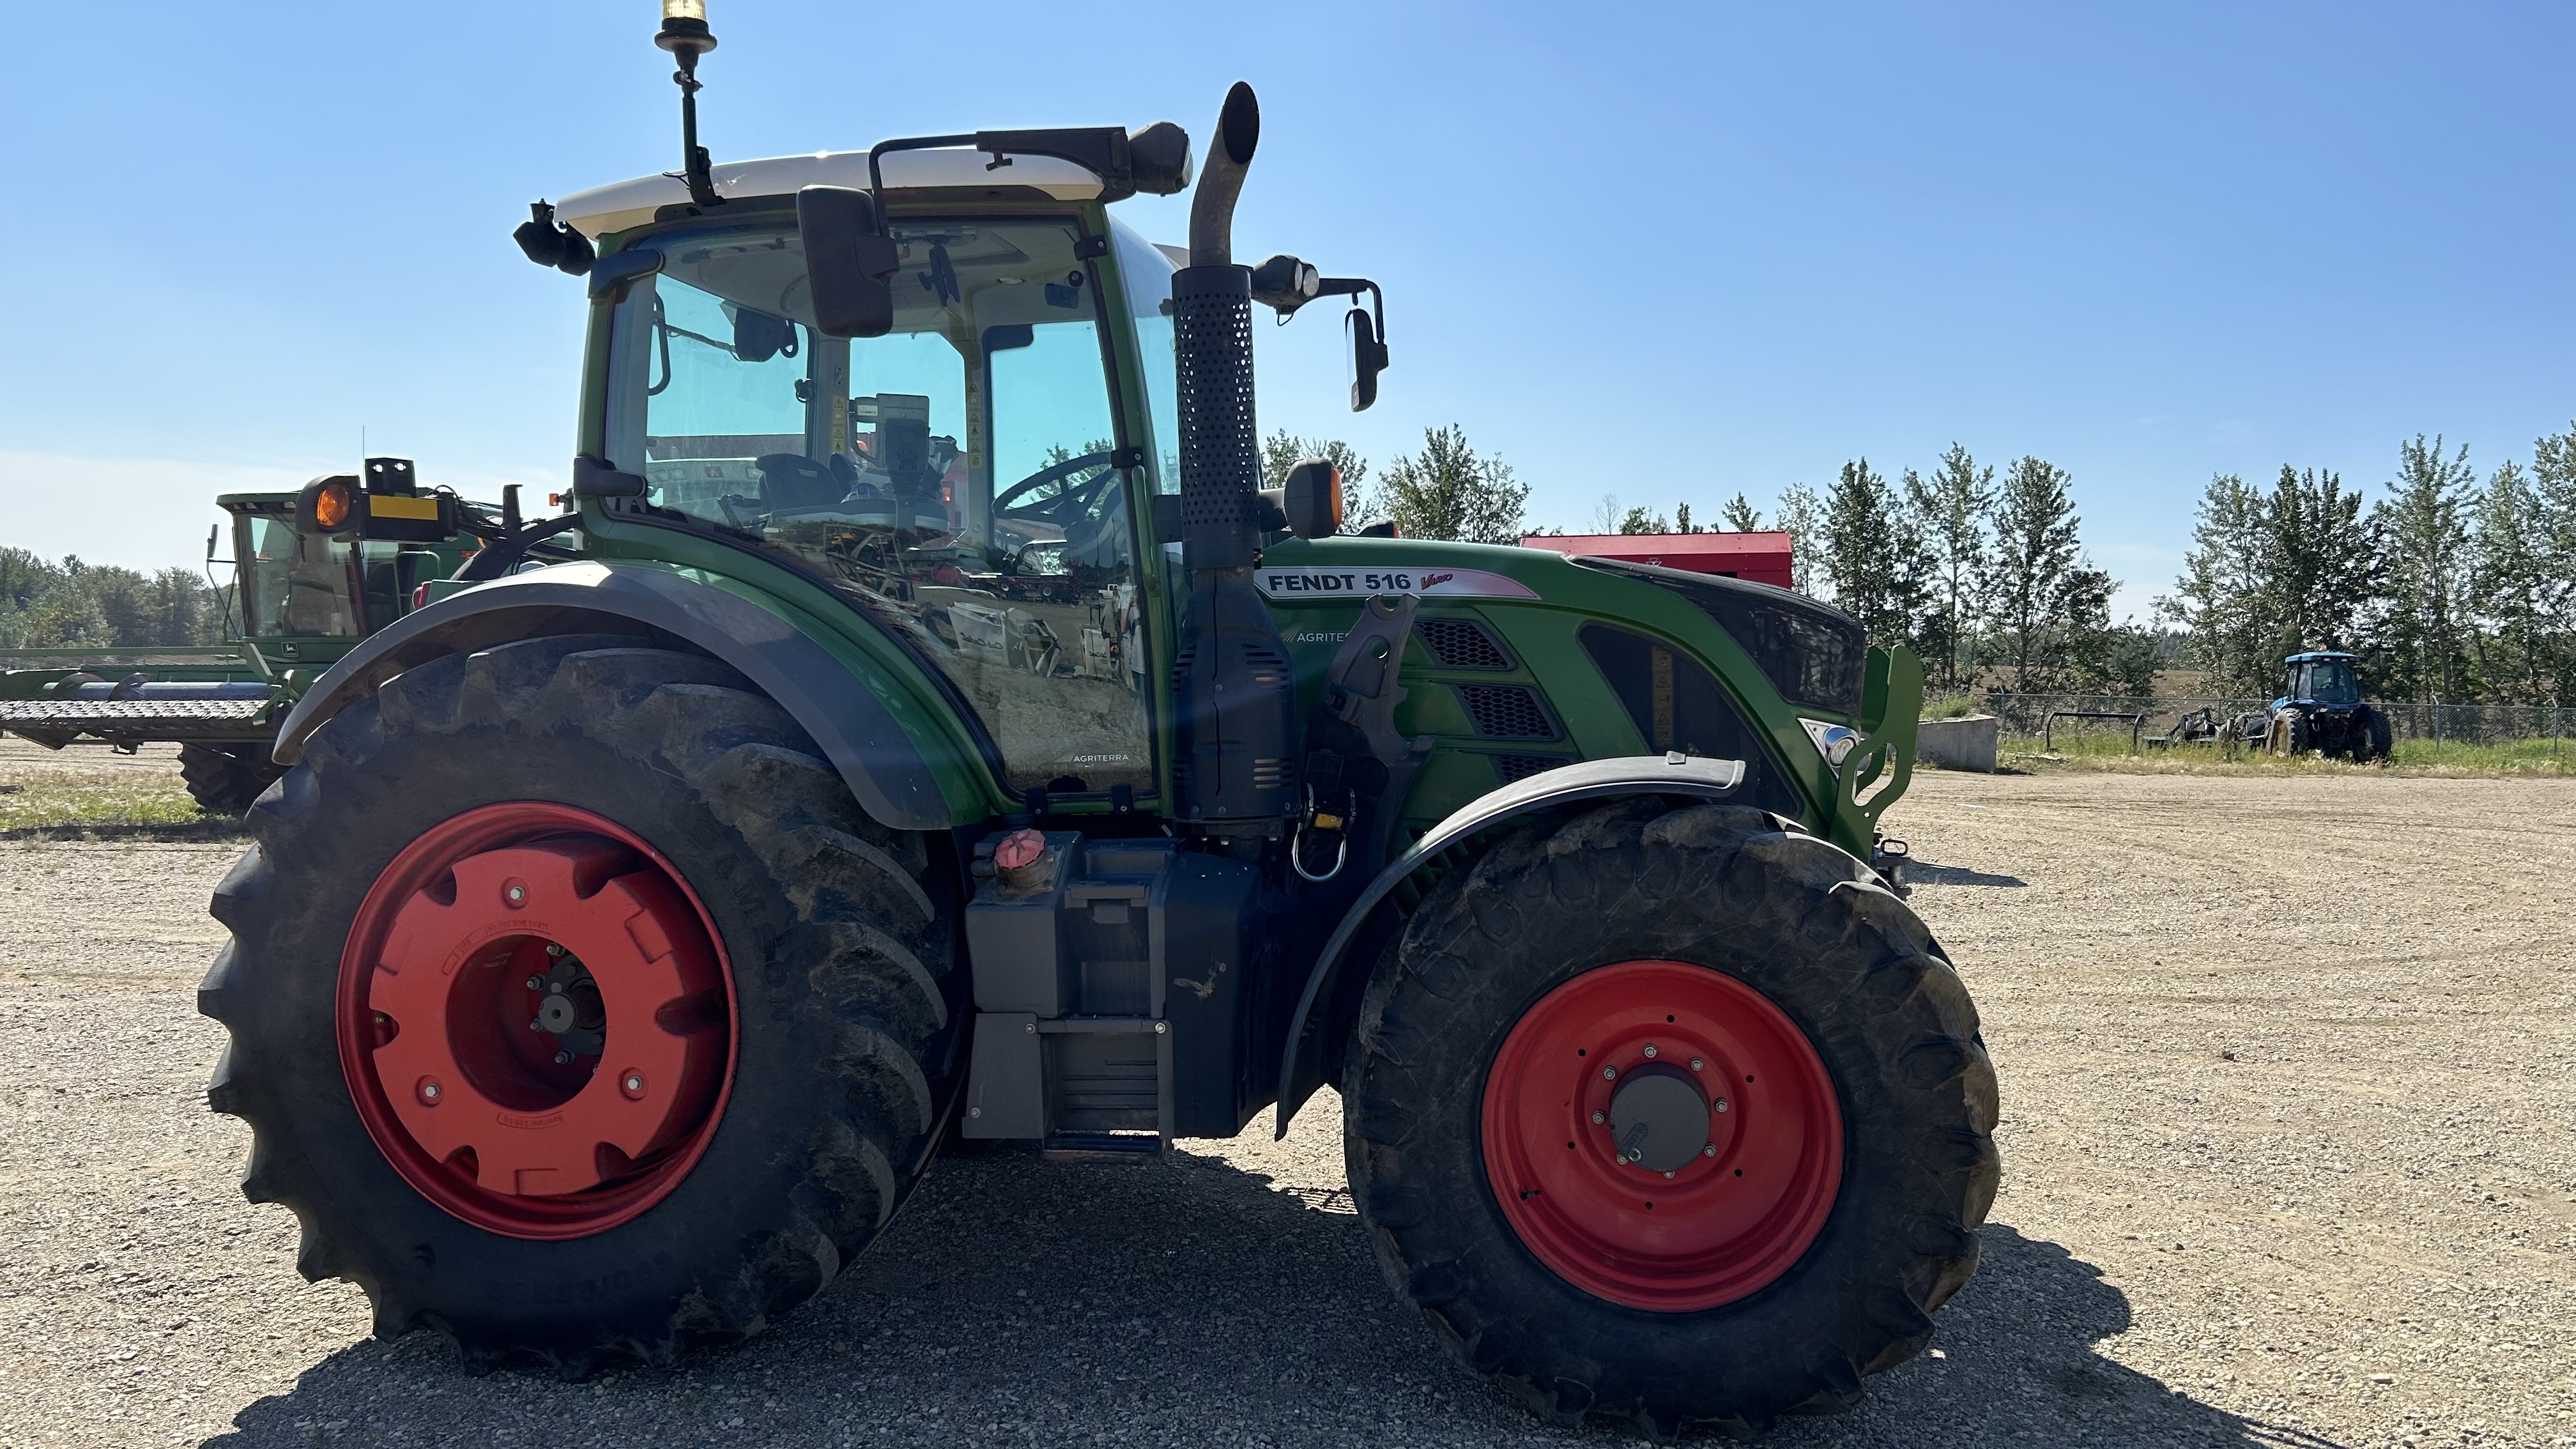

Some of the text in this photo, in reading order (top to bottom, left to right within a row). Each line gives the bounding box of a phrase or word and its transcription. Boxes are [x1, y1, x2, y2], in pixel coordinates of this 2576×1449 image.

[1268, 574, 1355, 591] FENDT
[1365, 574, 1411, 589] 516
[1296, 632, 1350, 642] AGRITE
[1073, 754, 1130, 762] AGRITERRA
